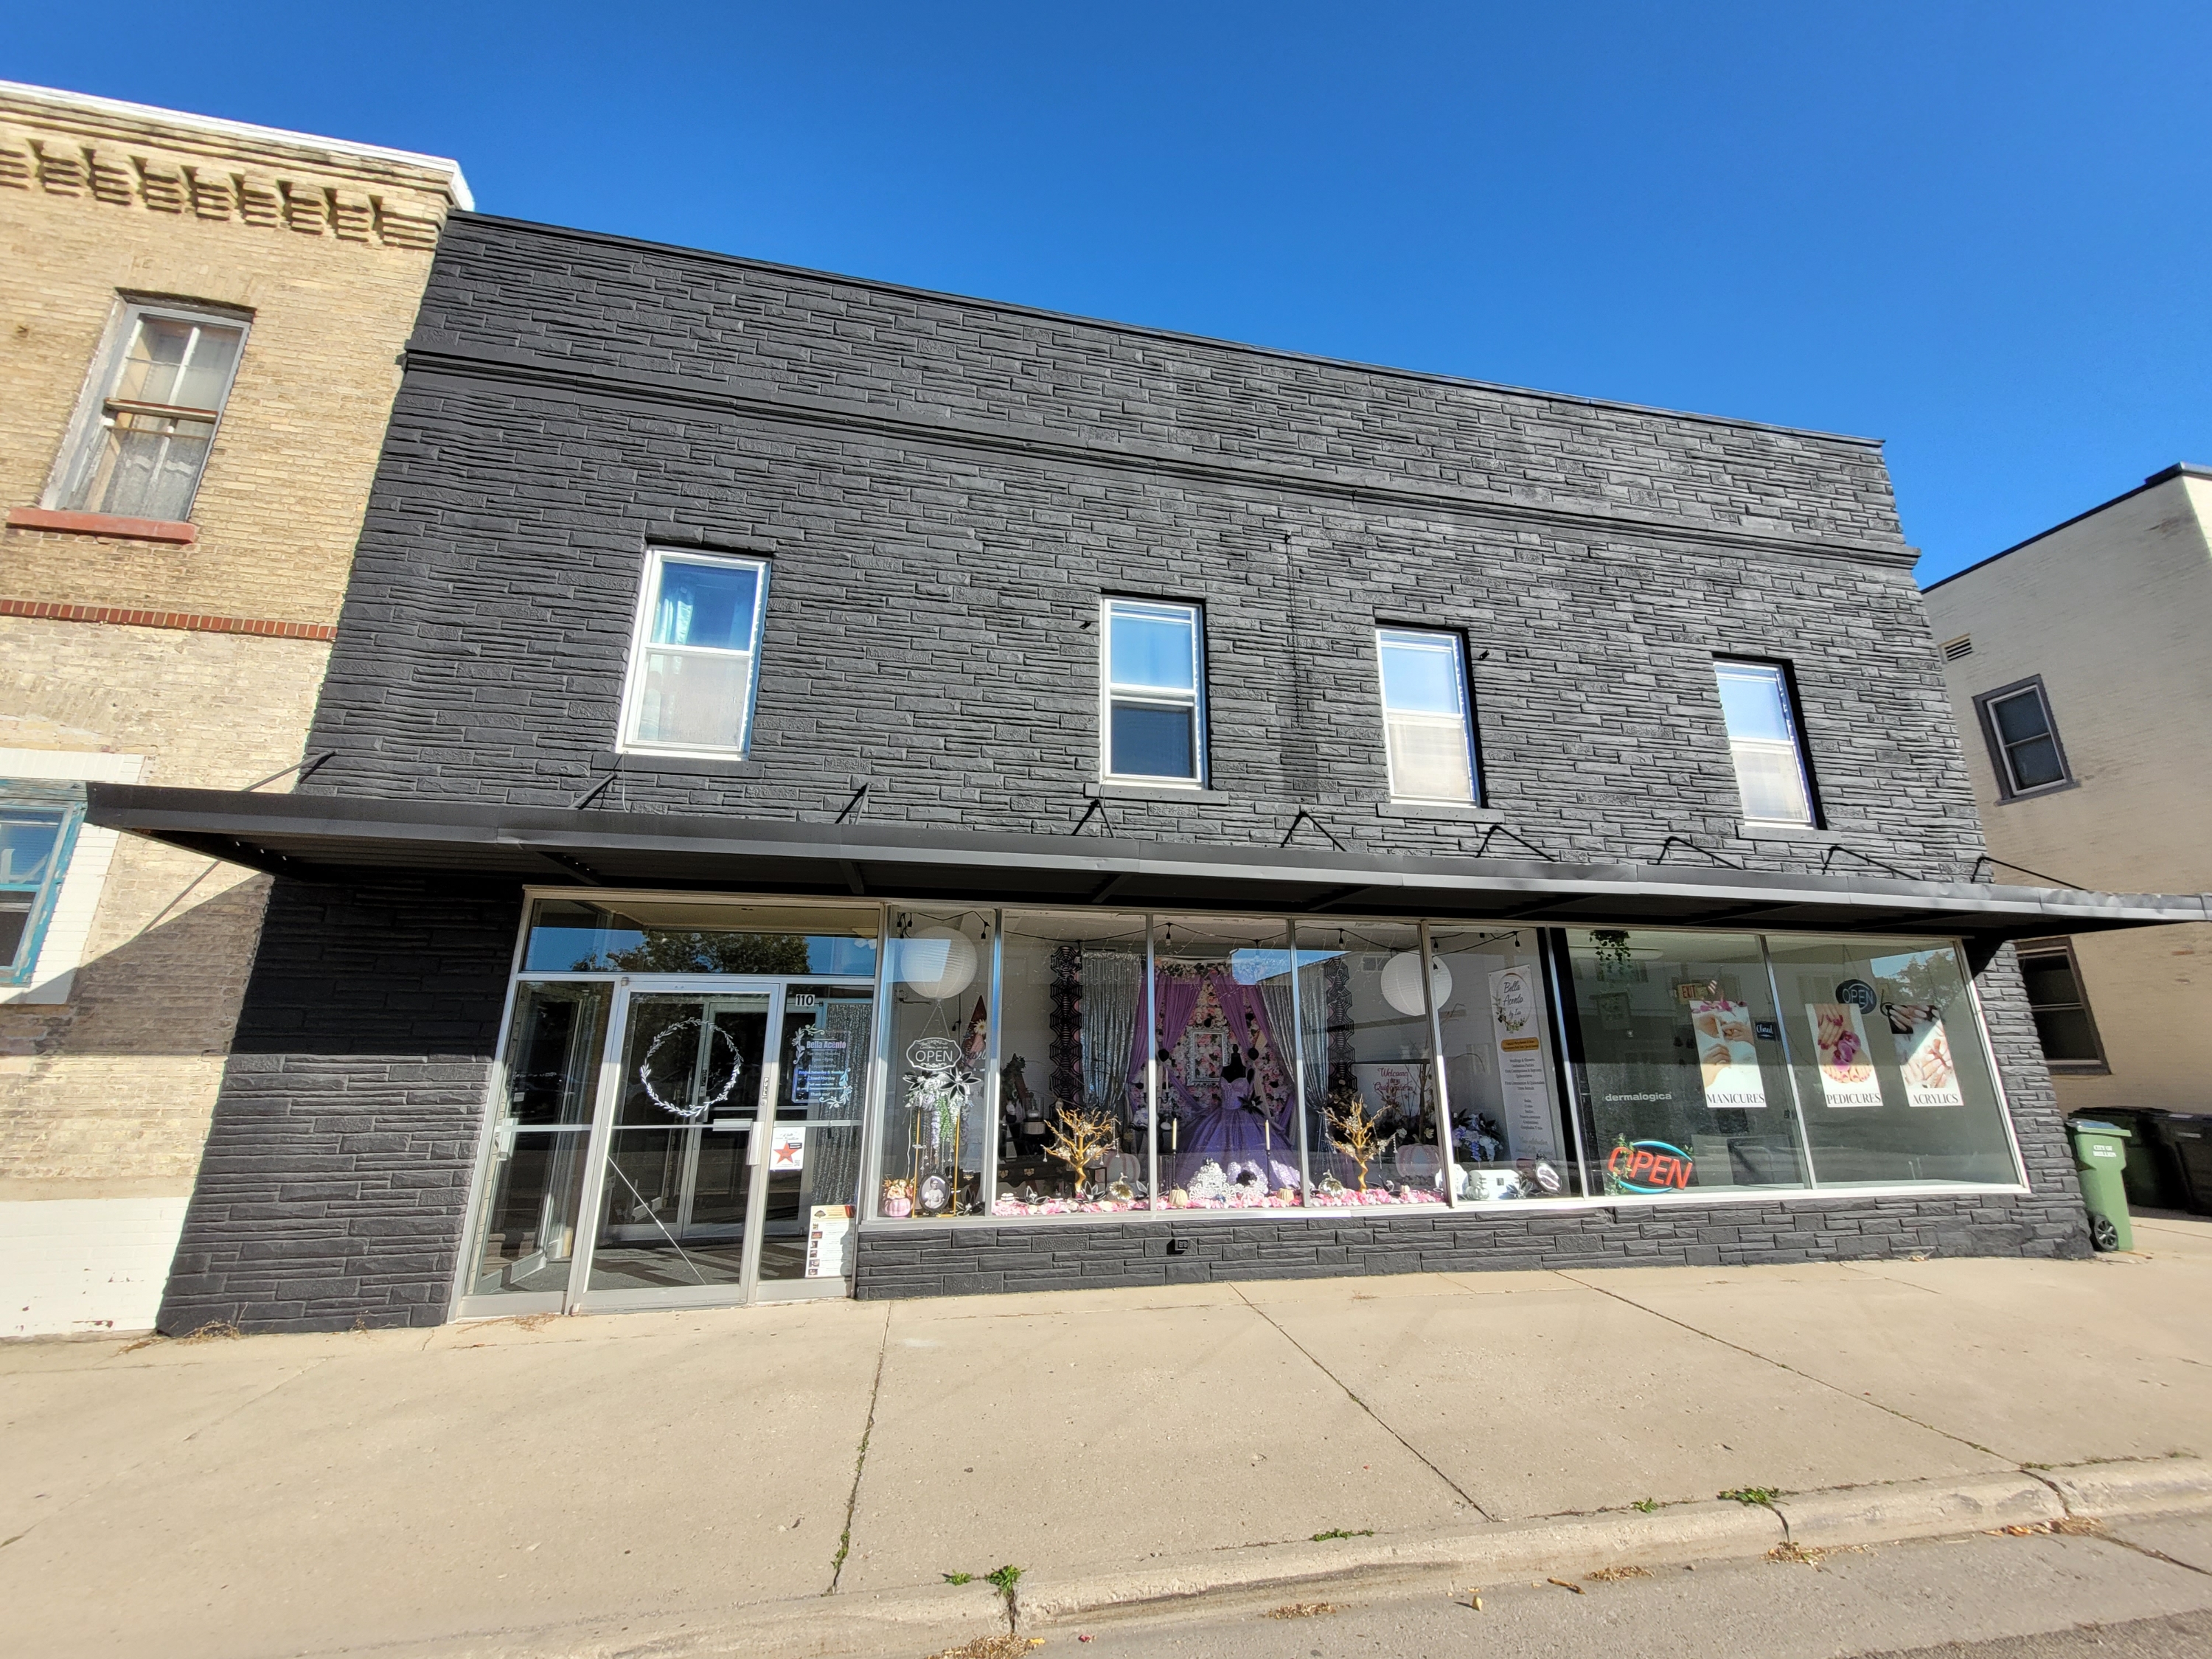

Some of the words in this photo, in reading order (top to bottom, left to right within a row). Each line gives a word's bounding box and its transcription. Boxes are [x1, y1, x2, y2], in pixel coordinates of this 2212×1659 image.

[1503, 980, 1520, 993] Bella
[1681, 985, 1696, 998] EXIT
[796, 995, 814, 1006] 110
[1503, 993, 1523, 1006] Acento
[1842, 988, 1874, 1004] OPEN
[806, 1040, 823, 1048] Bella
[824, 1040, 846, 1048] Acento
[915, 1050, 953, 1062] OPEN
[1377, 1067, 1408, 1077] Welcome
[1605, 1092, 1672, 1102] dermalogica
[1706, 1093, 1765, 1104] MANICURES
[1826, 1093, 1881, 1105] PEDICURES
[1913, 1093, 1959, 1105] ACRYLICS
[1608, 1147, 1693, 1190] OPEN
